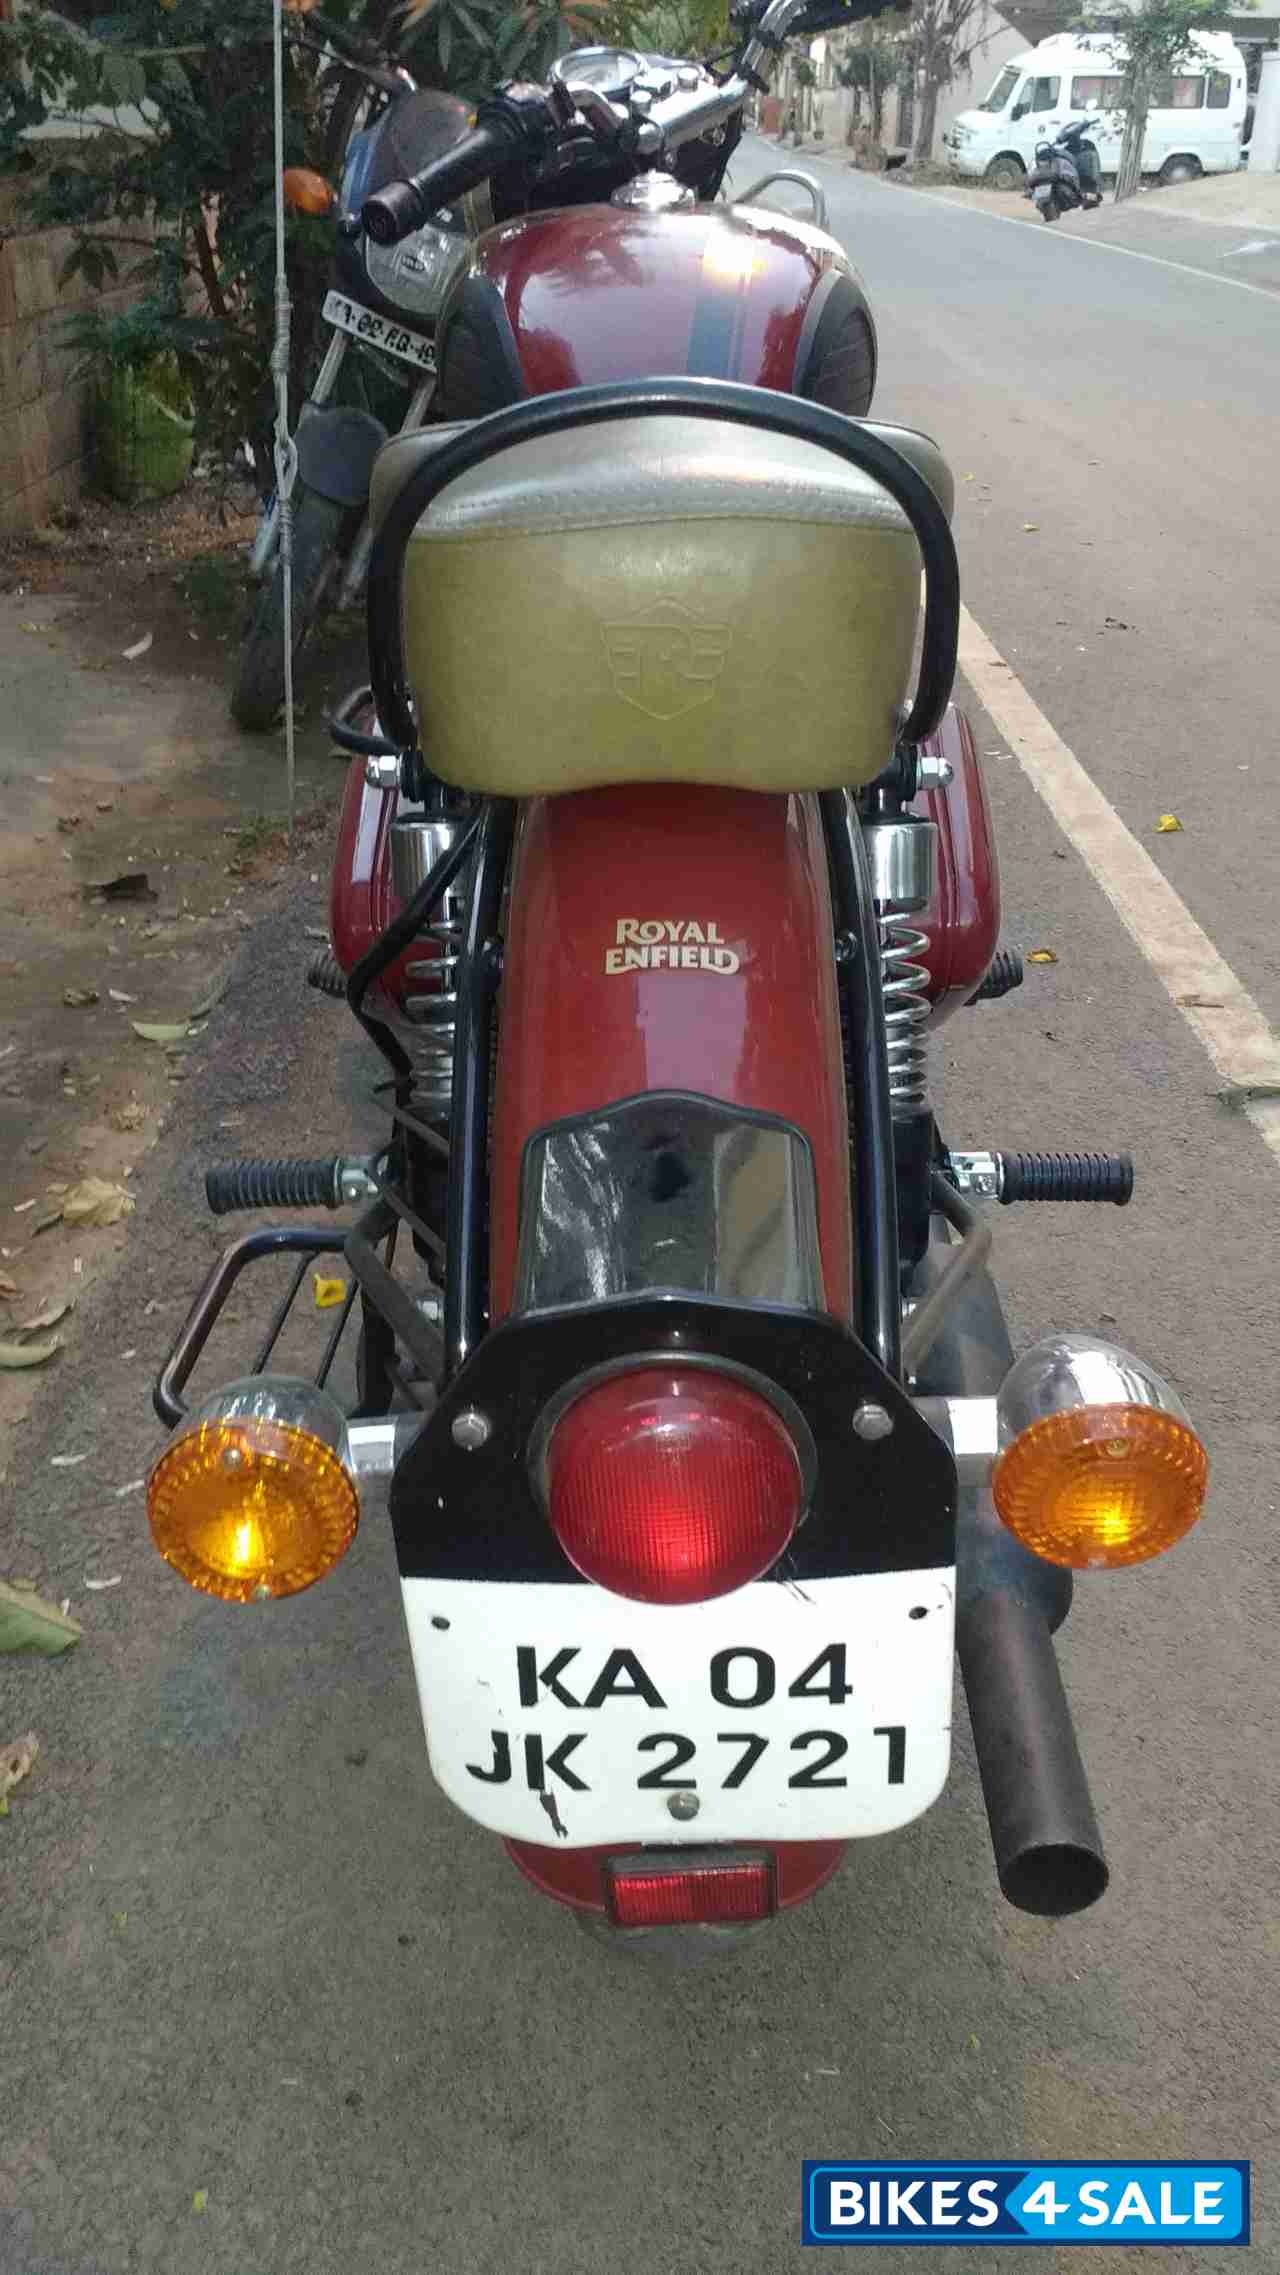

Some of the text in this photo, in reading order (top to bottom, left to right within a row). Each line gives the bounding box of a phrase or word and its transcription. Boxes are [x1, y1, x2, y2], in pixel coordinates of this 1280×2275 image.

[616, 918, 725, 945] ROYAL
[605, 945, 740, 975] ENFIELD
[516, 1643, 853, 1709] KA 04
[466, 1726, 906, 1791] JK 2721
